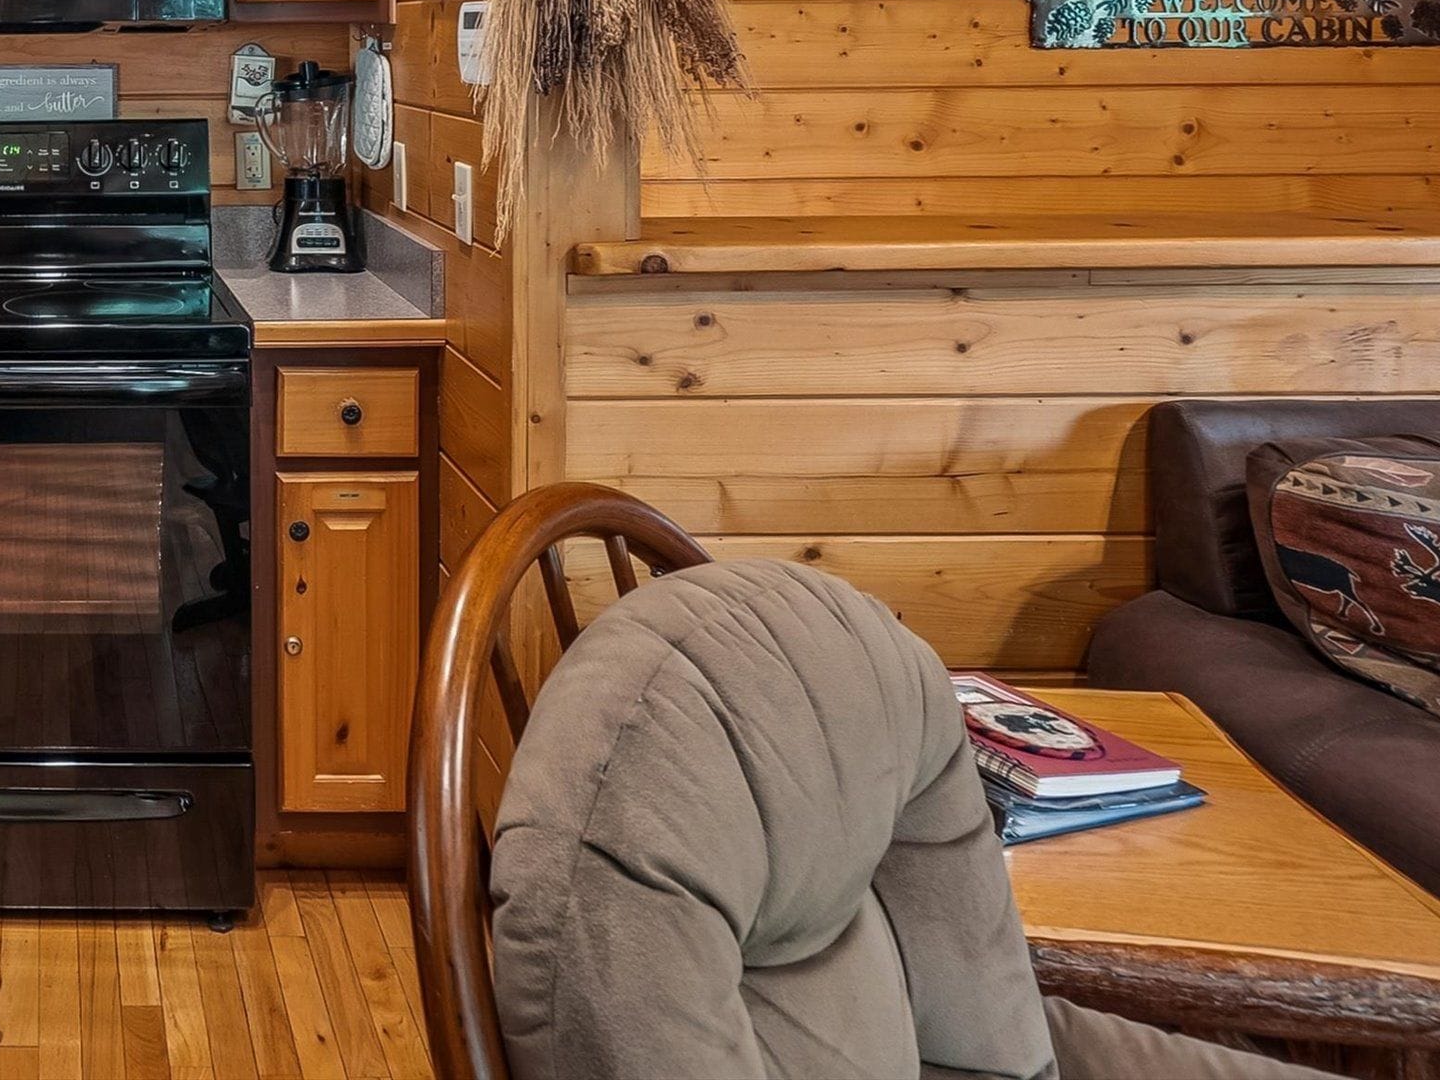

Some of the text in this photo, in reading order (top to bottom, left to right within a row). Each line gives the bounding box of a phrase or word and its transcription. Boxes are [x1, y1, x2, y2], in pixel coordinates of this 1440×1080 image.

[1122, 16, 1379, 47] TO OUR CABIN
[47, 76, 57, 86] is
[60, 74, 97, 89] always
[27, 91, 105, 113] butter
